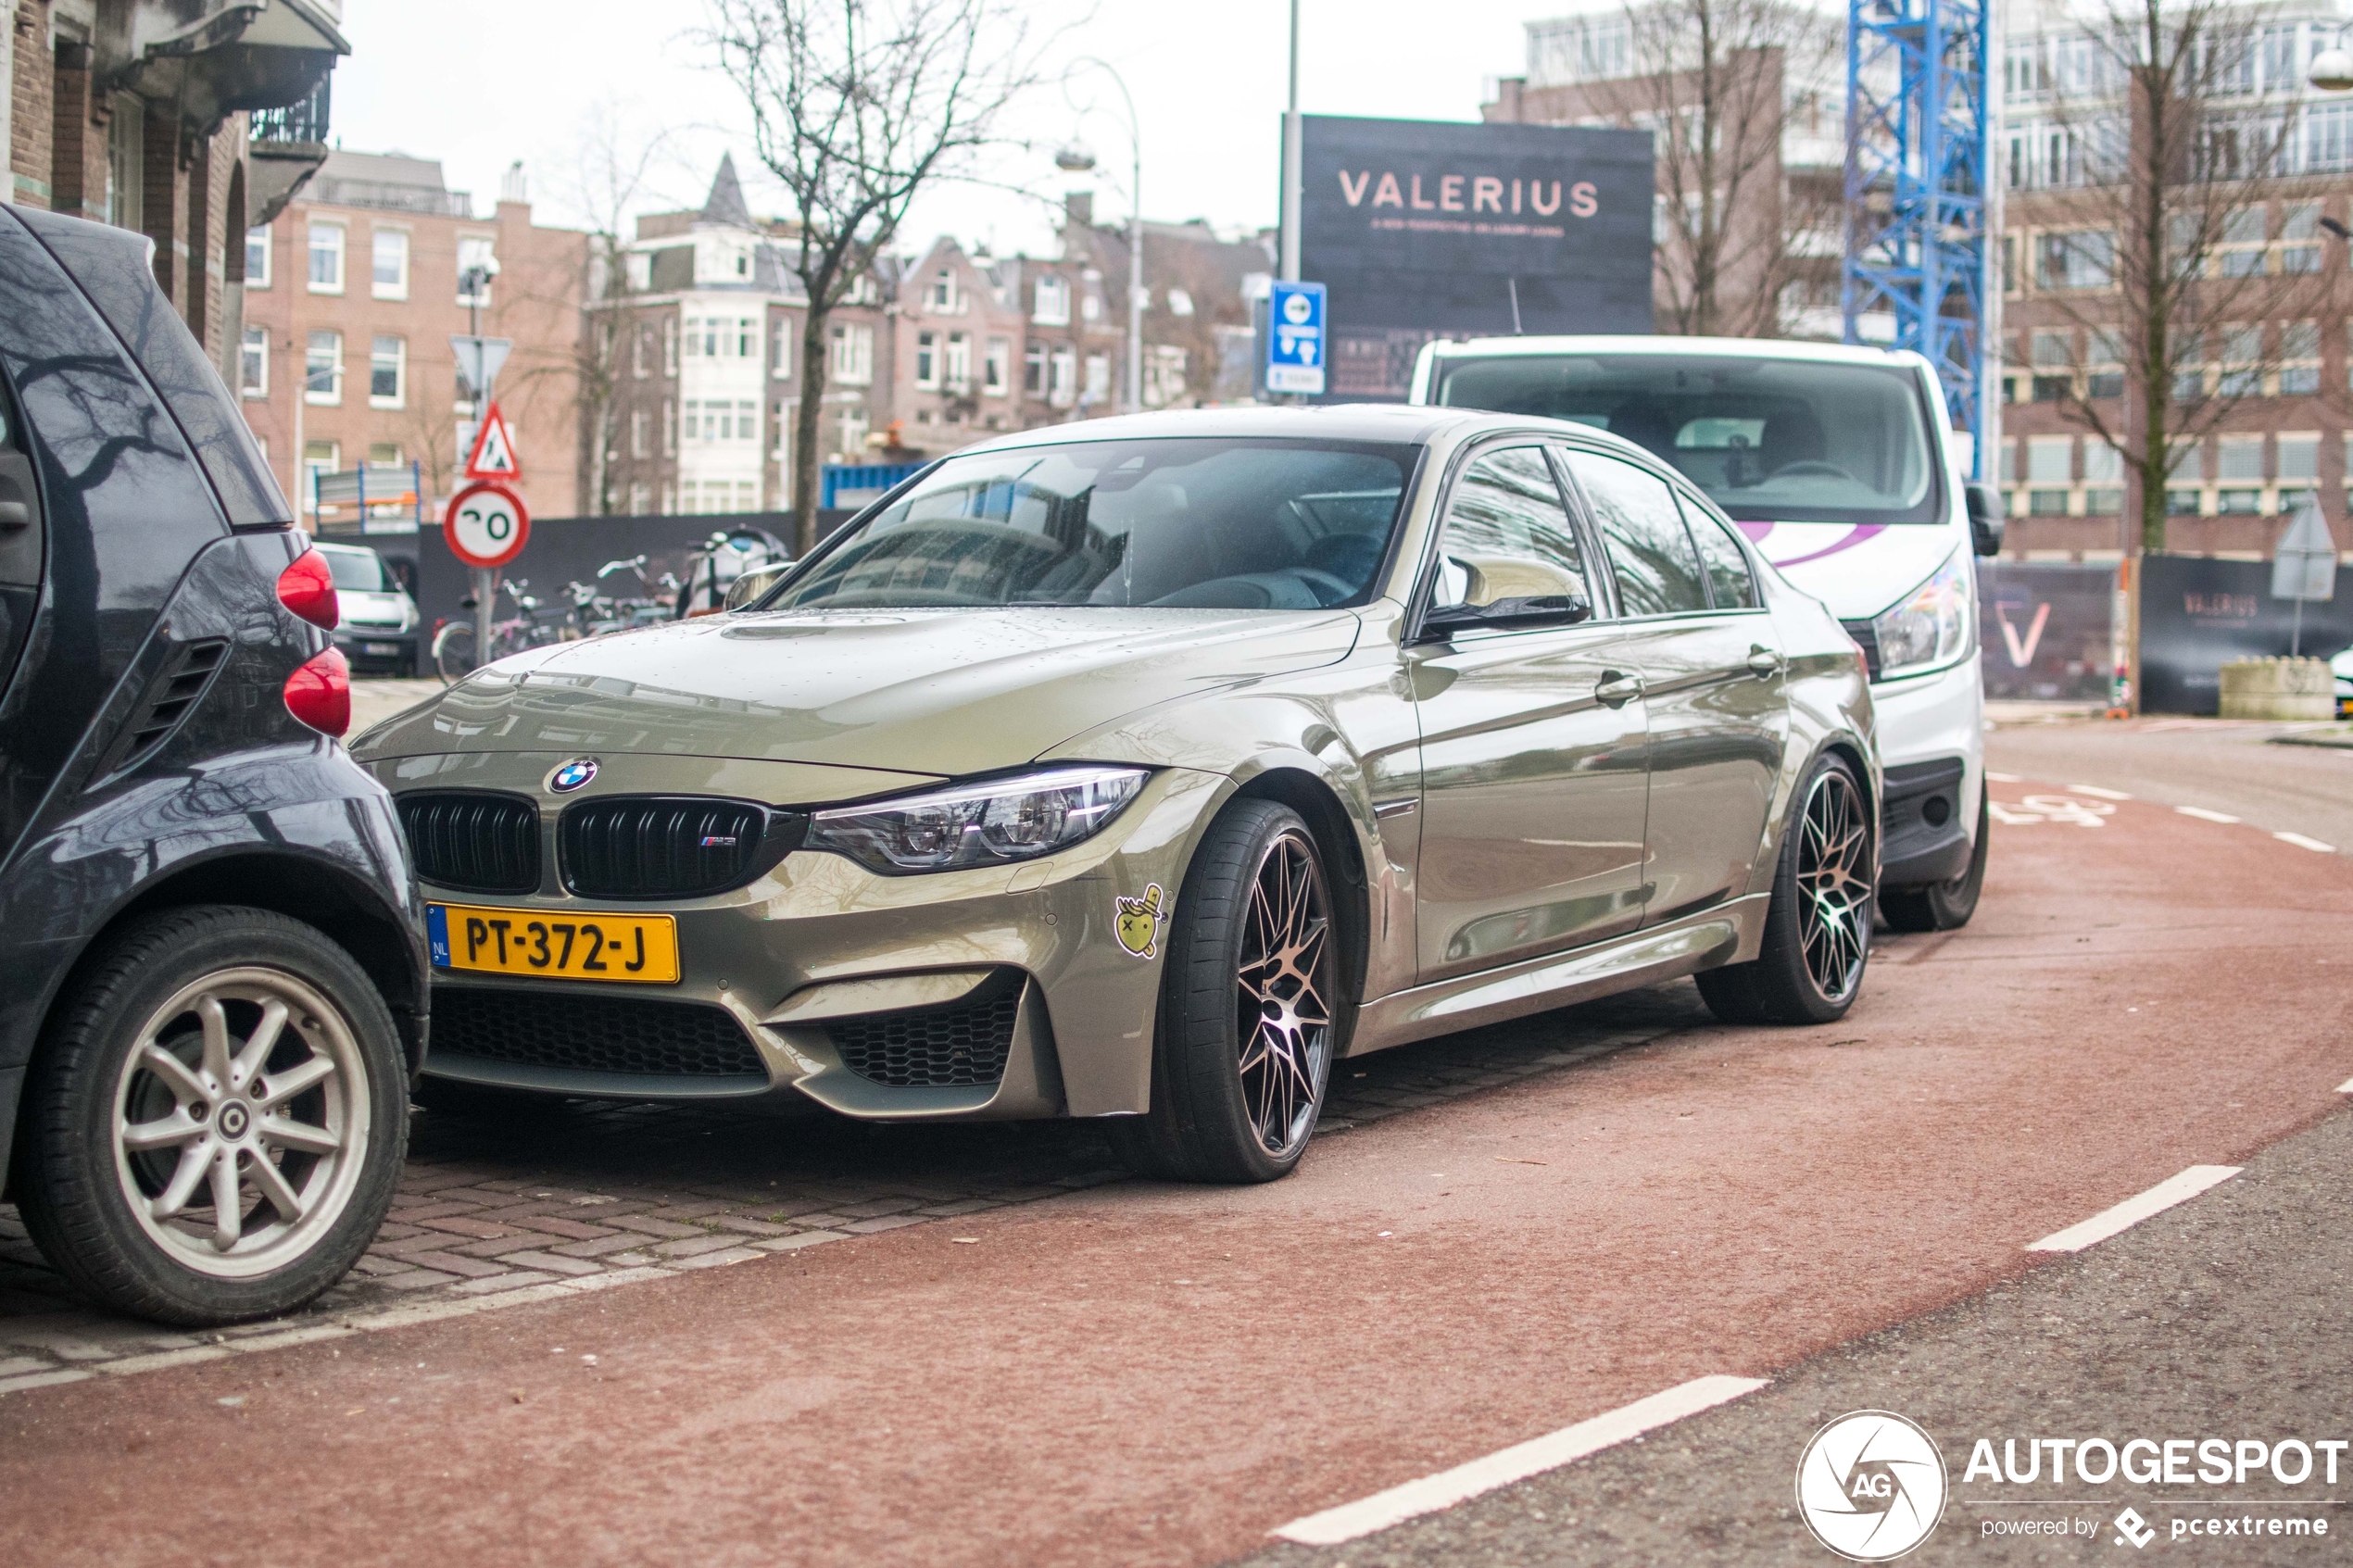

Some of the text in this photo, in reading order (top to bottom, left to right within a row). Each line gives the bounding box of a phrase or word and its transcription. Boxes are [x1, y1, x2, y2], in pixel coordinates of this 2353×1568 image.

[1339, 169, 1599, 218] VALERIUS
[434, 941, 448, 956] NL
[466, 917, 646, 972] PT-372-J
